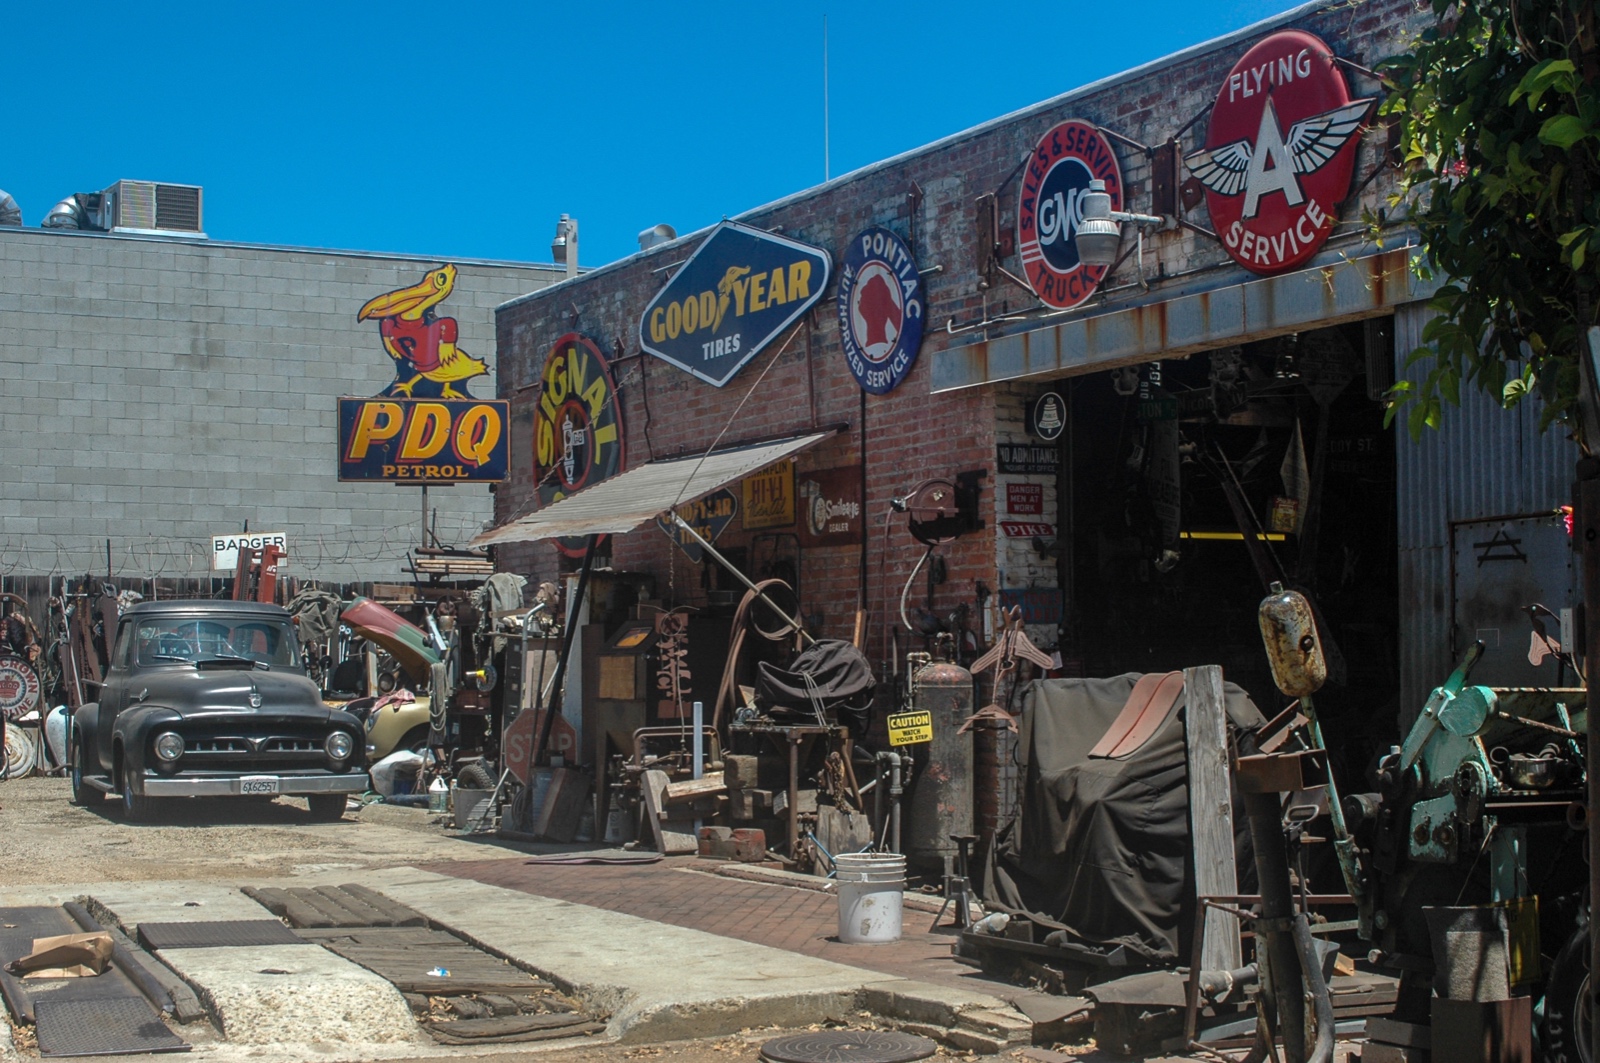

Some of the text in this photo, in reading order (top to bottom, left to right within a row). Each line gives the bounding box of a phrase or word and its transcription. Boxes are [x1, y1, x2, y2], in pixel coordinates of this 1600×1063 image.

[1229, 48, 1311, 103] FLYING
[1022, 145, 1050, 232] SALES
[1051, 131, 1063, 157] &
[1224, 198, 1326, 266] SERVICE
[862, 233, 922, 320] PONTIAC
[1035, 264, 1106, 303] TRUCK
[837, 263, 909, 389] AUTHORIZED SERVICE
[702, 333, 741, 361] TIRES
[537, 347, 618, 468] SIGNAL
[343, 402, 502, 467] PDQ
[999, 446, 1060, 464] NO ADMITTANCE
[382, 464, 470, 478] PETROL
[1009, 485, 1041, 494] DANGER
[1010, 495, 1040, 503] MEN AT
[825, 498, 860, 520] Smileage
[1013, 503, 1036, 512] WORK
[829, 522, 849, 533] DEALER
[1005, 524, 1050, 536] PIKE
[215, 536, 286, 552] BADGER
[0, 657, 38, 693] CROWN
[890, 714, 929, 729] CAUTION
[902, 728, 921, 736] WATCH
[242, 781, 277, 792] 6X62557
